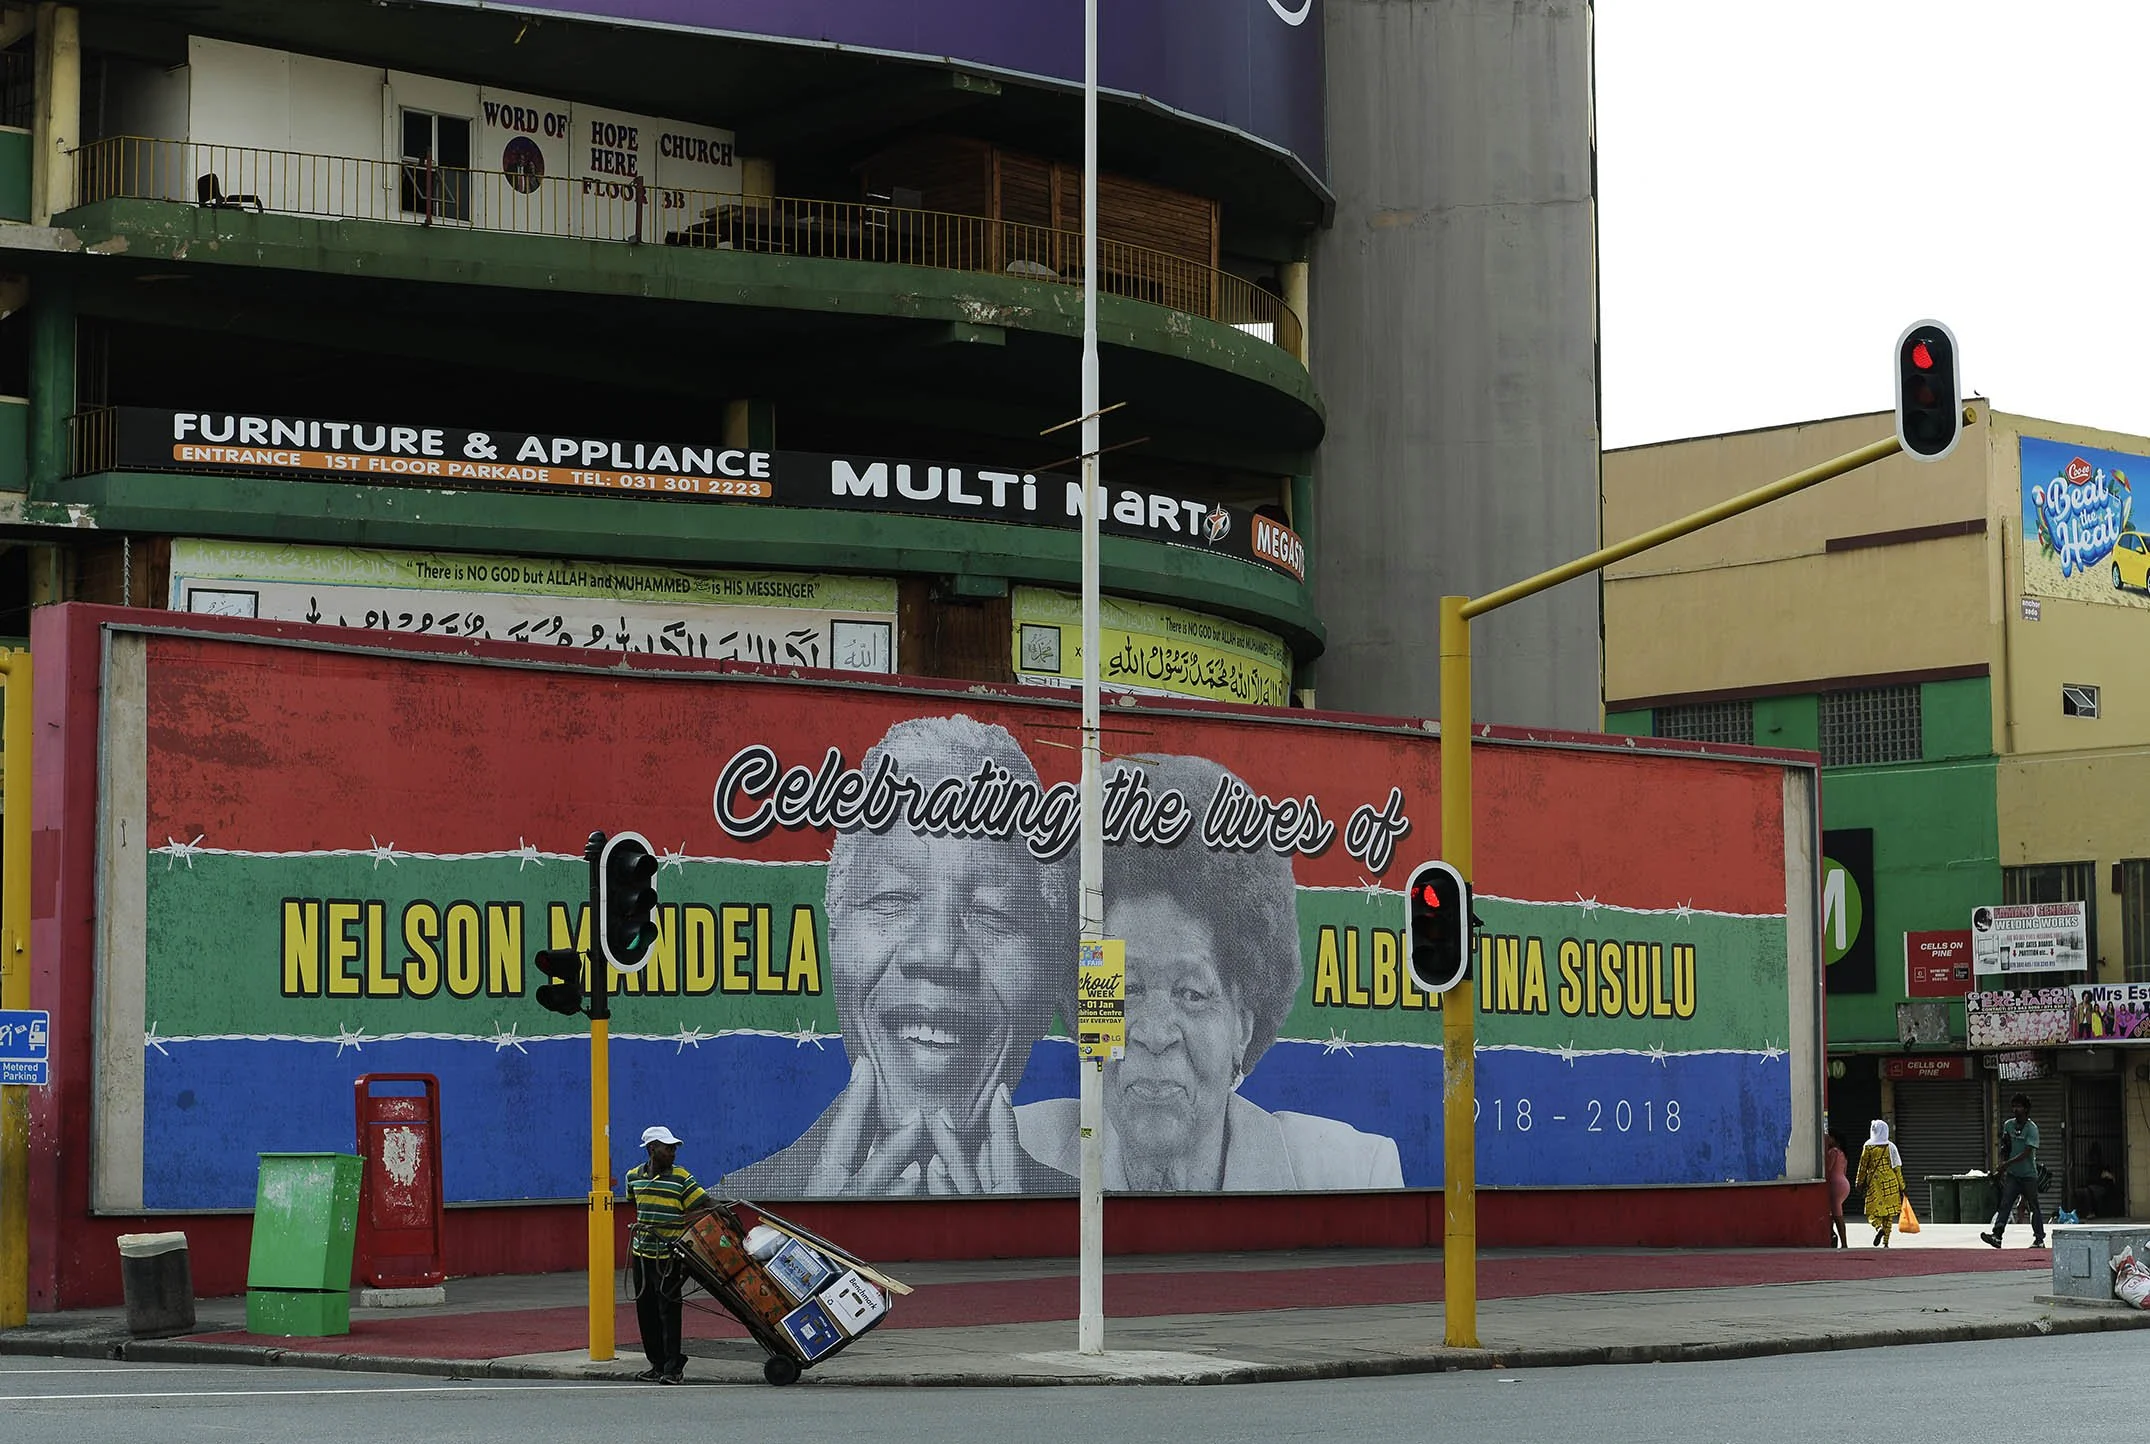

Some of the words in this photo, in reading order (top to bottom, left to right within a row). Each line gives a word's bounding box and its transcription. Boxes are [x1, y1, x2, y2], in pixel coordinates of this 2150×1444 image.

[482, 101, 539, 134] WORD
[544, 112, 567, 139] OF
[591, 120, 639, 151] HOPE
[660, 132, 733, 167] CHURCH
[591, 147, 638, 178] HERE
[174, 413, 445, 456] FURNITURE
[463, 432, 497, 461] &
[516, 436, 771, 479] APPLIANCE
[181, 447, 300, 466] ENTRANCE
[325, 454, 361, 470] 1ST
[368, 457, 440, 476] FLOOR
[448, 462, 549, 483] PARKADE
[571, 471, 611, 487] TEL:
[620, 474, 656, 490] 031
[663, 477, 701, 492] 301
[708, 480, 762, 497] 2223
[2047, 468, 2109, 524] Beat
[2079, 508, 2097, 526] the
[2057, 507, 2120, 568] Heat
[454, 565, 464, 580] is
[467, 565, 487, 582] NO
[491, 567, 520, 583] GOD
[523, 568, 544, 584] but
[546, 569, 587, 587] ALLAH
[590, 574, 611, 588] and
[614, 575, 690, 593] MUHAMMED
[712, 583, 721, 595] is
[724, 580, 743, 596] HIS
[1182, 622, 1188, 634] is
[1188, 623, 1198, 637] NO
[1199, 624, 1212, 639] GOD
[713, 744, 1081, 860] Celebrating
[1101, 766, 1192, 845] the
[1203, 773, 1335, 854] lives
[1344, 786, 1408, 873] of
[2036, 903, 2081, 918] GENERAL
[1995, 918, 2039, 931] WELDING
[2040, 916, 2079, 929] WORKS
[281, 897, 524, 998] NELSON
[1920, 942, 1948, 950] CELLS
[1312, 924, 1550, 1015] ALBEINA
[1557, 937, 1697, 1020] SISULU
[1088, 990, 1115, 998] WEEK
[1967, 990, 2015, 1001] GOLD
[1982, 996, 2069, 1008] EXCHANG
[2093, 987, 2122, 1002] Mrs
[1099, 1000, 1114, 1008] Jan
[3, 1062, 38, 1071] Metered
[1907, 1061, 1935, 1069] CELLS
[1937, 1061, 1950, 1069] ON
[3, 1072, 37, 1082] Parking
[1462, 1098, 1532, 1132] 18
[1587, 1099, 1682, 1133] 2018
[849, 1277, 879, 1310] Benchmark
